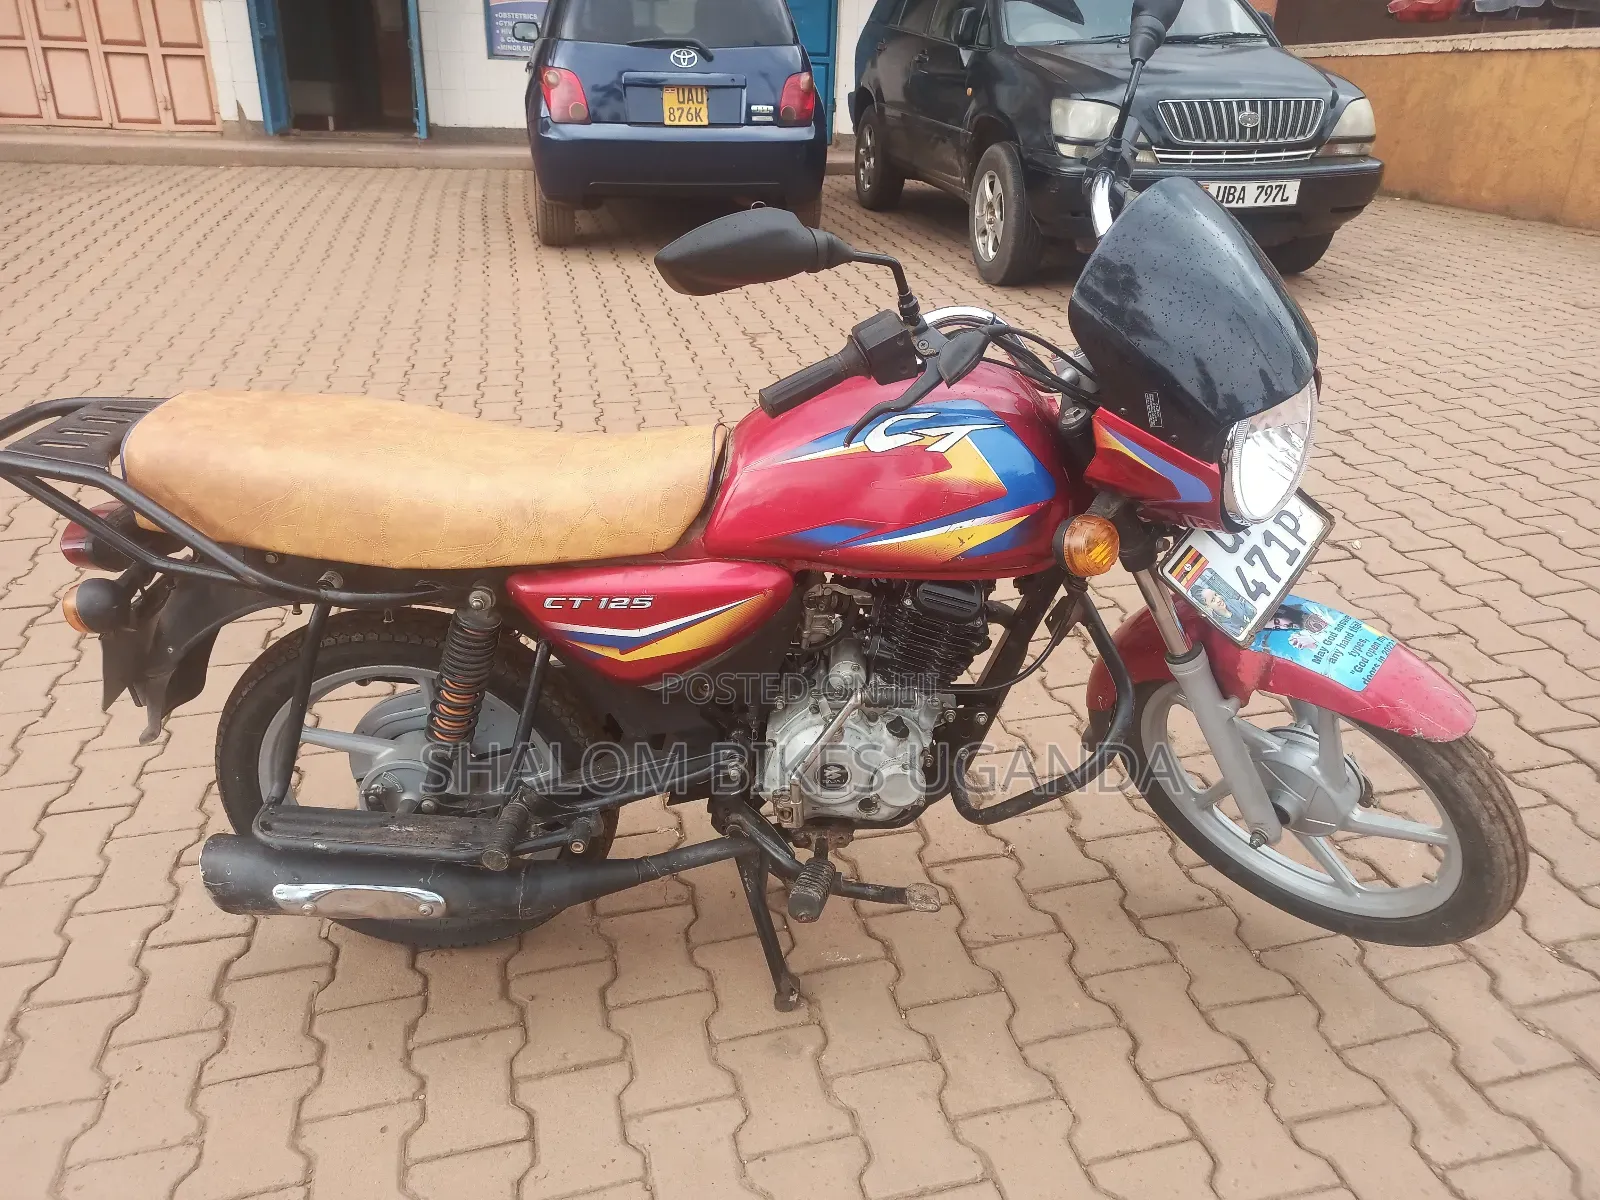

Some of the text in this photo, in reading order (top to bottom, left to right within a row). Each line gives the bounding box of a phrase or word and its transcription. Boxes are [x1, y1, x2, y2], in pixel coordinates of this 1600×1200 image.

[677, 88, 704, 104] UAU
[668, 106, 704, 122] 876K
[1215, 183, 1290, 205] UBA 797L
[1235, 509, 1308, 602] 471P
[543, 596, 654, 609] CT 125
[1311, 645, 1330, 665] May
[1322, 631, 1339, 647] God
[1328, 648, 1344, 665] any
[1336, 631, 1355, 650] hand
